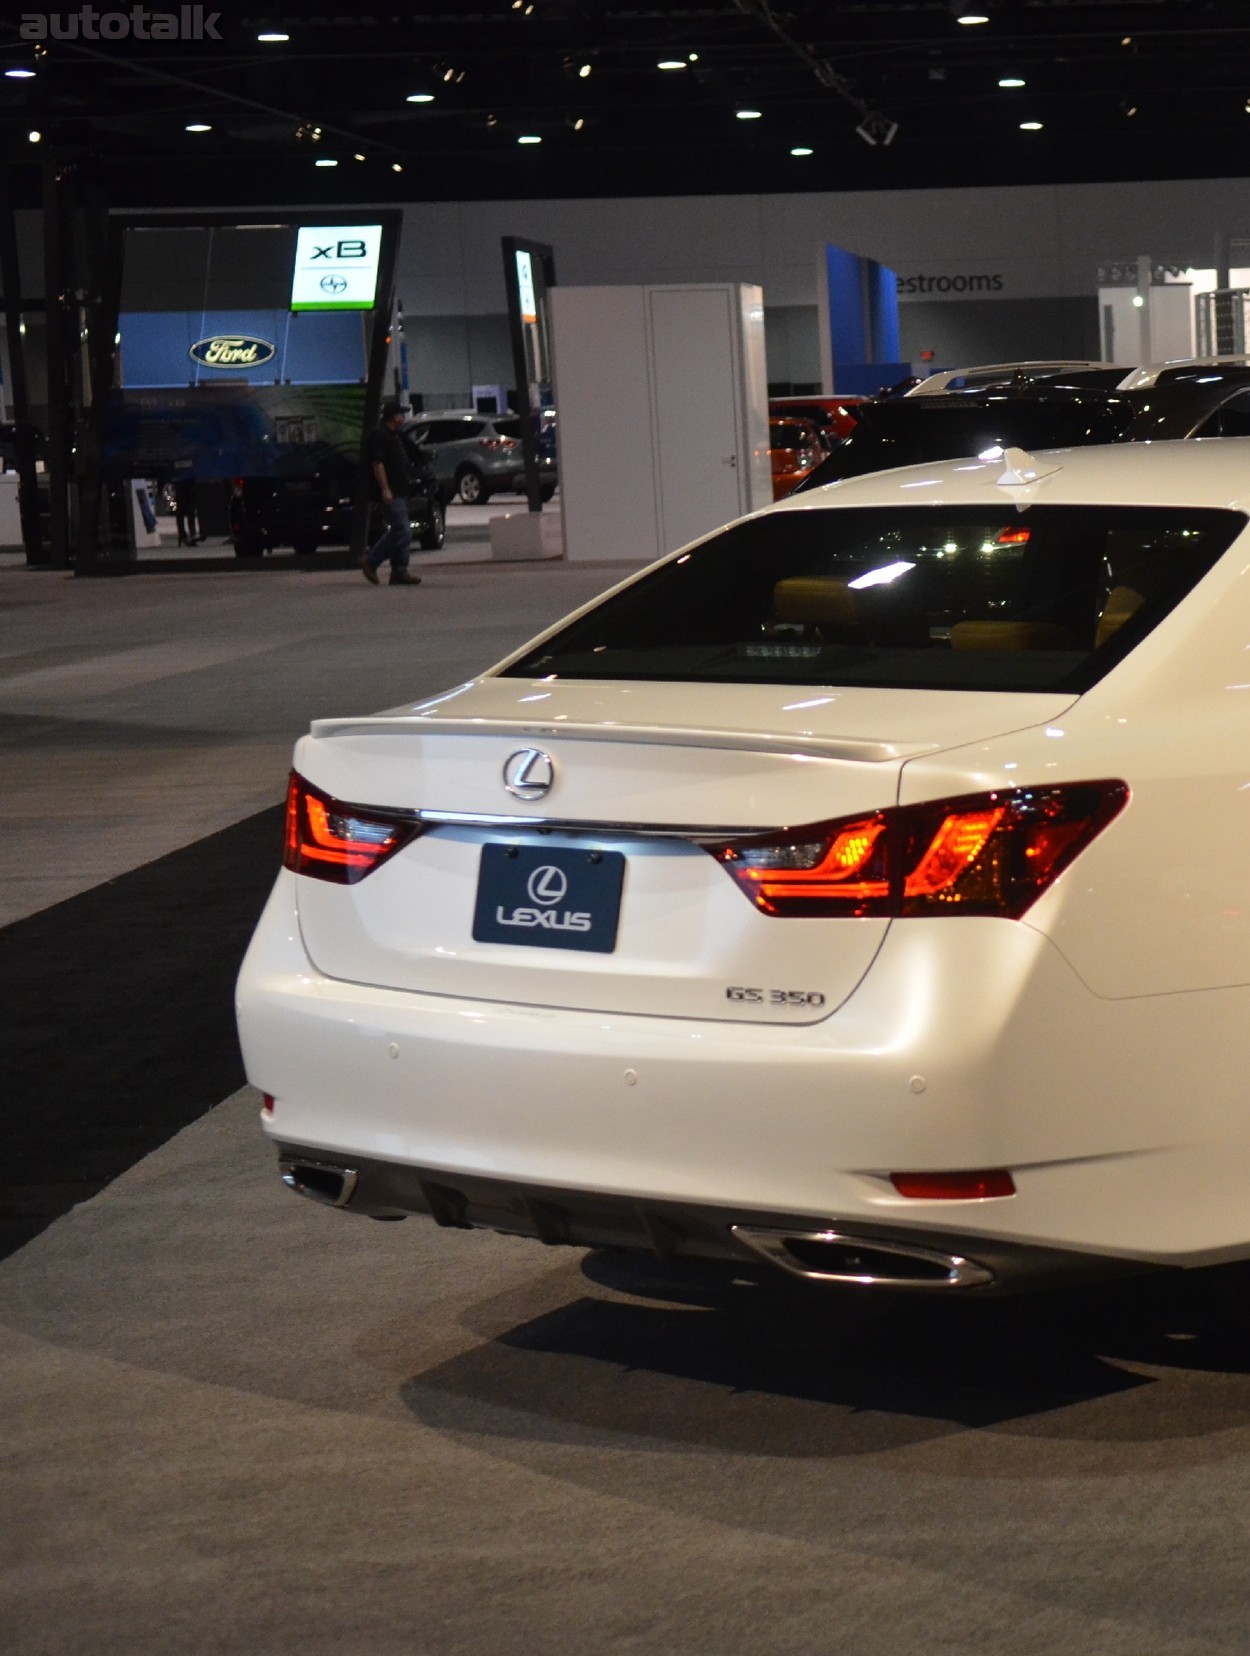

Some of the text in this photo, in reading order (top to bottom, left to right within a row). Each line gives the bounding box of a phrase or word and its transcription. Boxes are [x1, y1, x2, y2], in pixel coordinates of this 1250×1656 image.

[309, 240, 367, 260] xB
[897, 273, 1004, 294] estrooms
[205, 338, 258, 363] Ford
[496, 905, 592, 932] LEXUS
[726, 986, 826, 1008] GS 350
